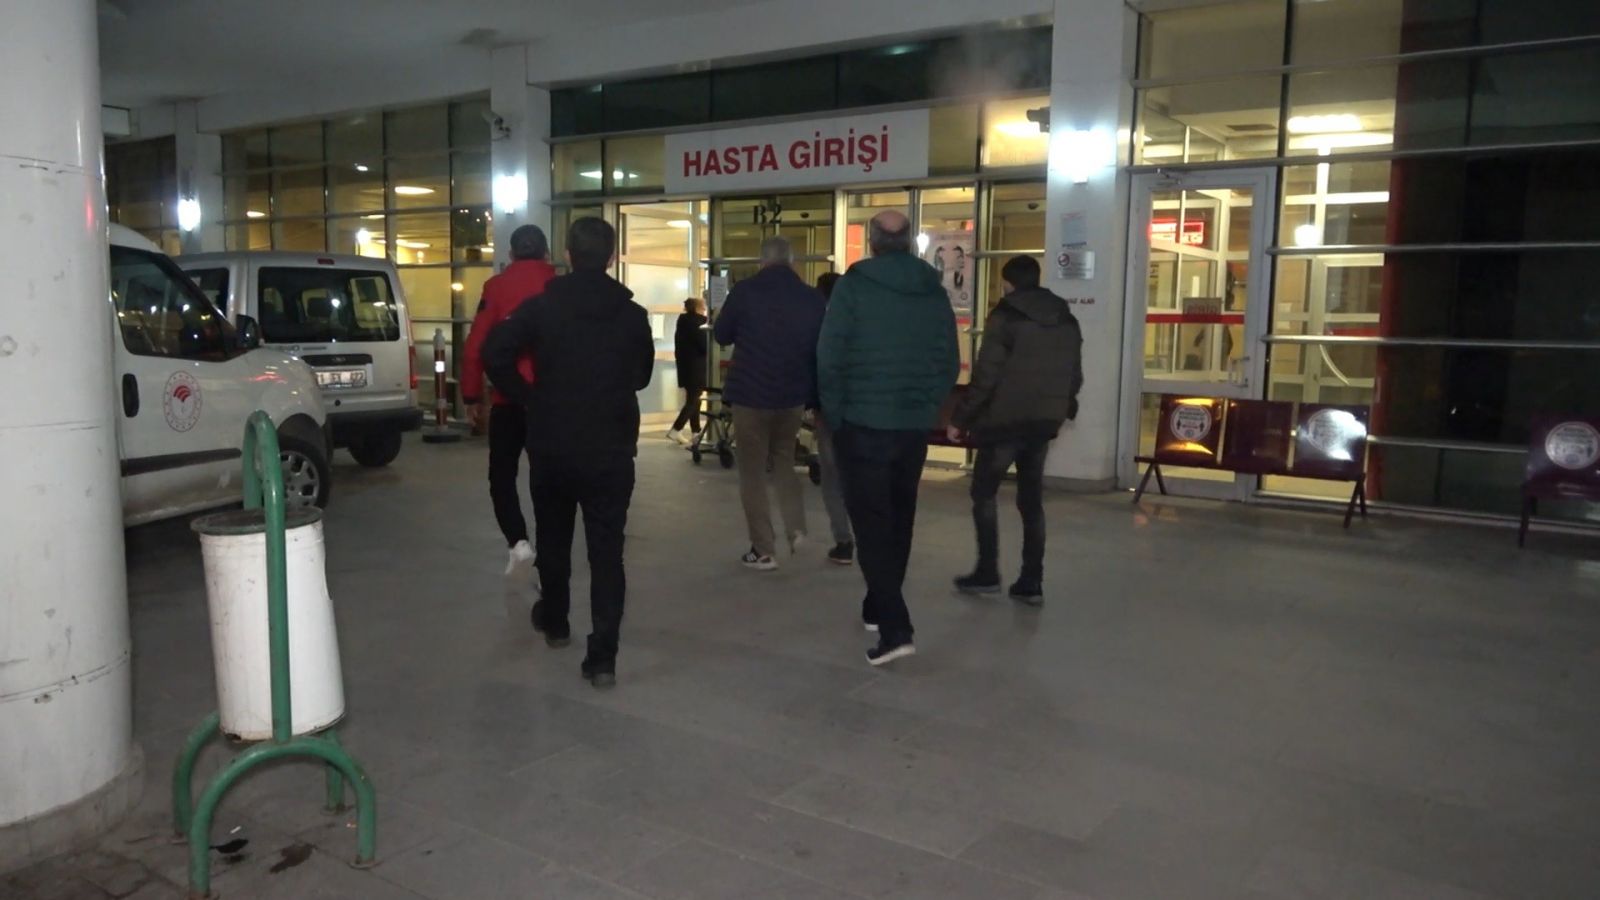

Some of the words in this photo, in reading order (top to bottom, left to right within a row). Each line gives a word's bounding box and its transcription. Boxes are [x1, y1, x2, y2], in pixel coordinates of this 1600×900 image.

[683, 143, 779, 177] HASTA
[788, 125, 889, 172] GİRİŞİ
[753, 204, 782, 225] B2
